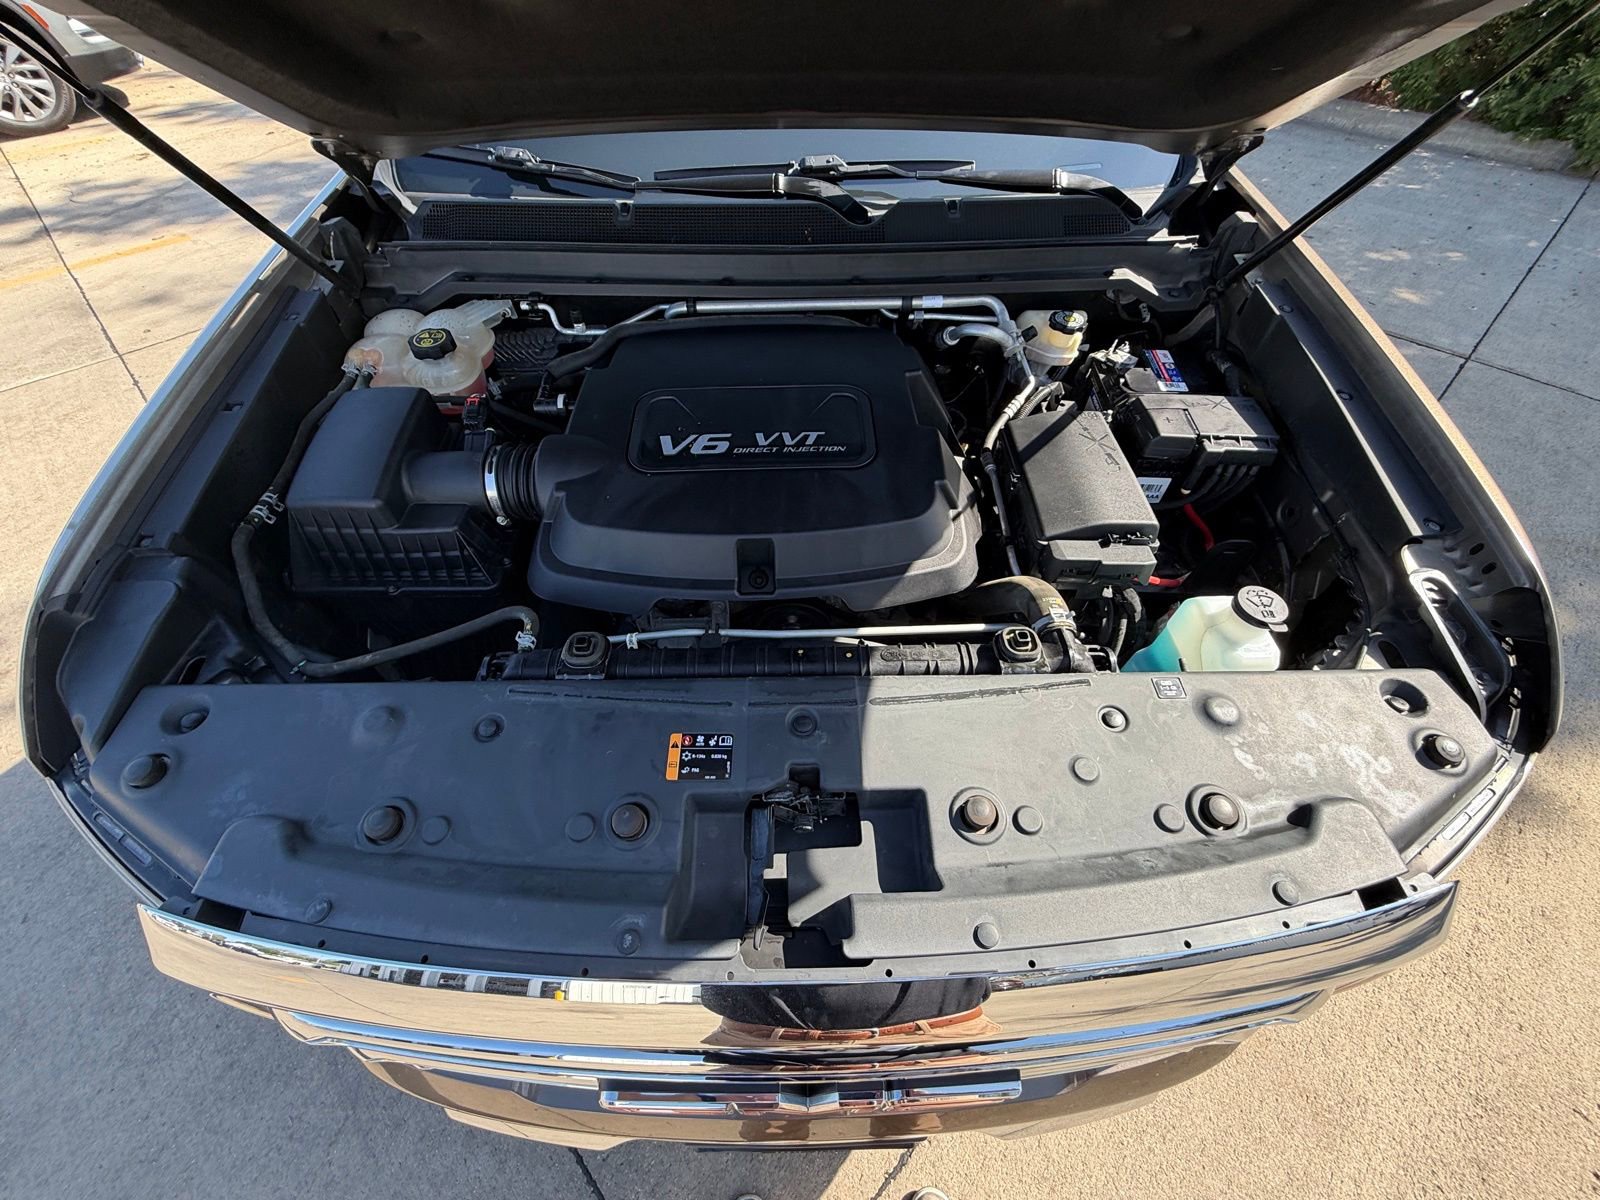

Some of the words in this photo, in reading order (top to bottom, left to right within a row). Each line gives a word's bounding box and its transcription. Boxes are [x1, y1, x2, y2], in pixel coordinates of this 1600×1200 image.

[659, 433, 733, 456] V6
[755, 431, 826, 446] VVT
[733, 446, 779, 454] DIRECT
[783, 445, 847, 453] INJECTION
